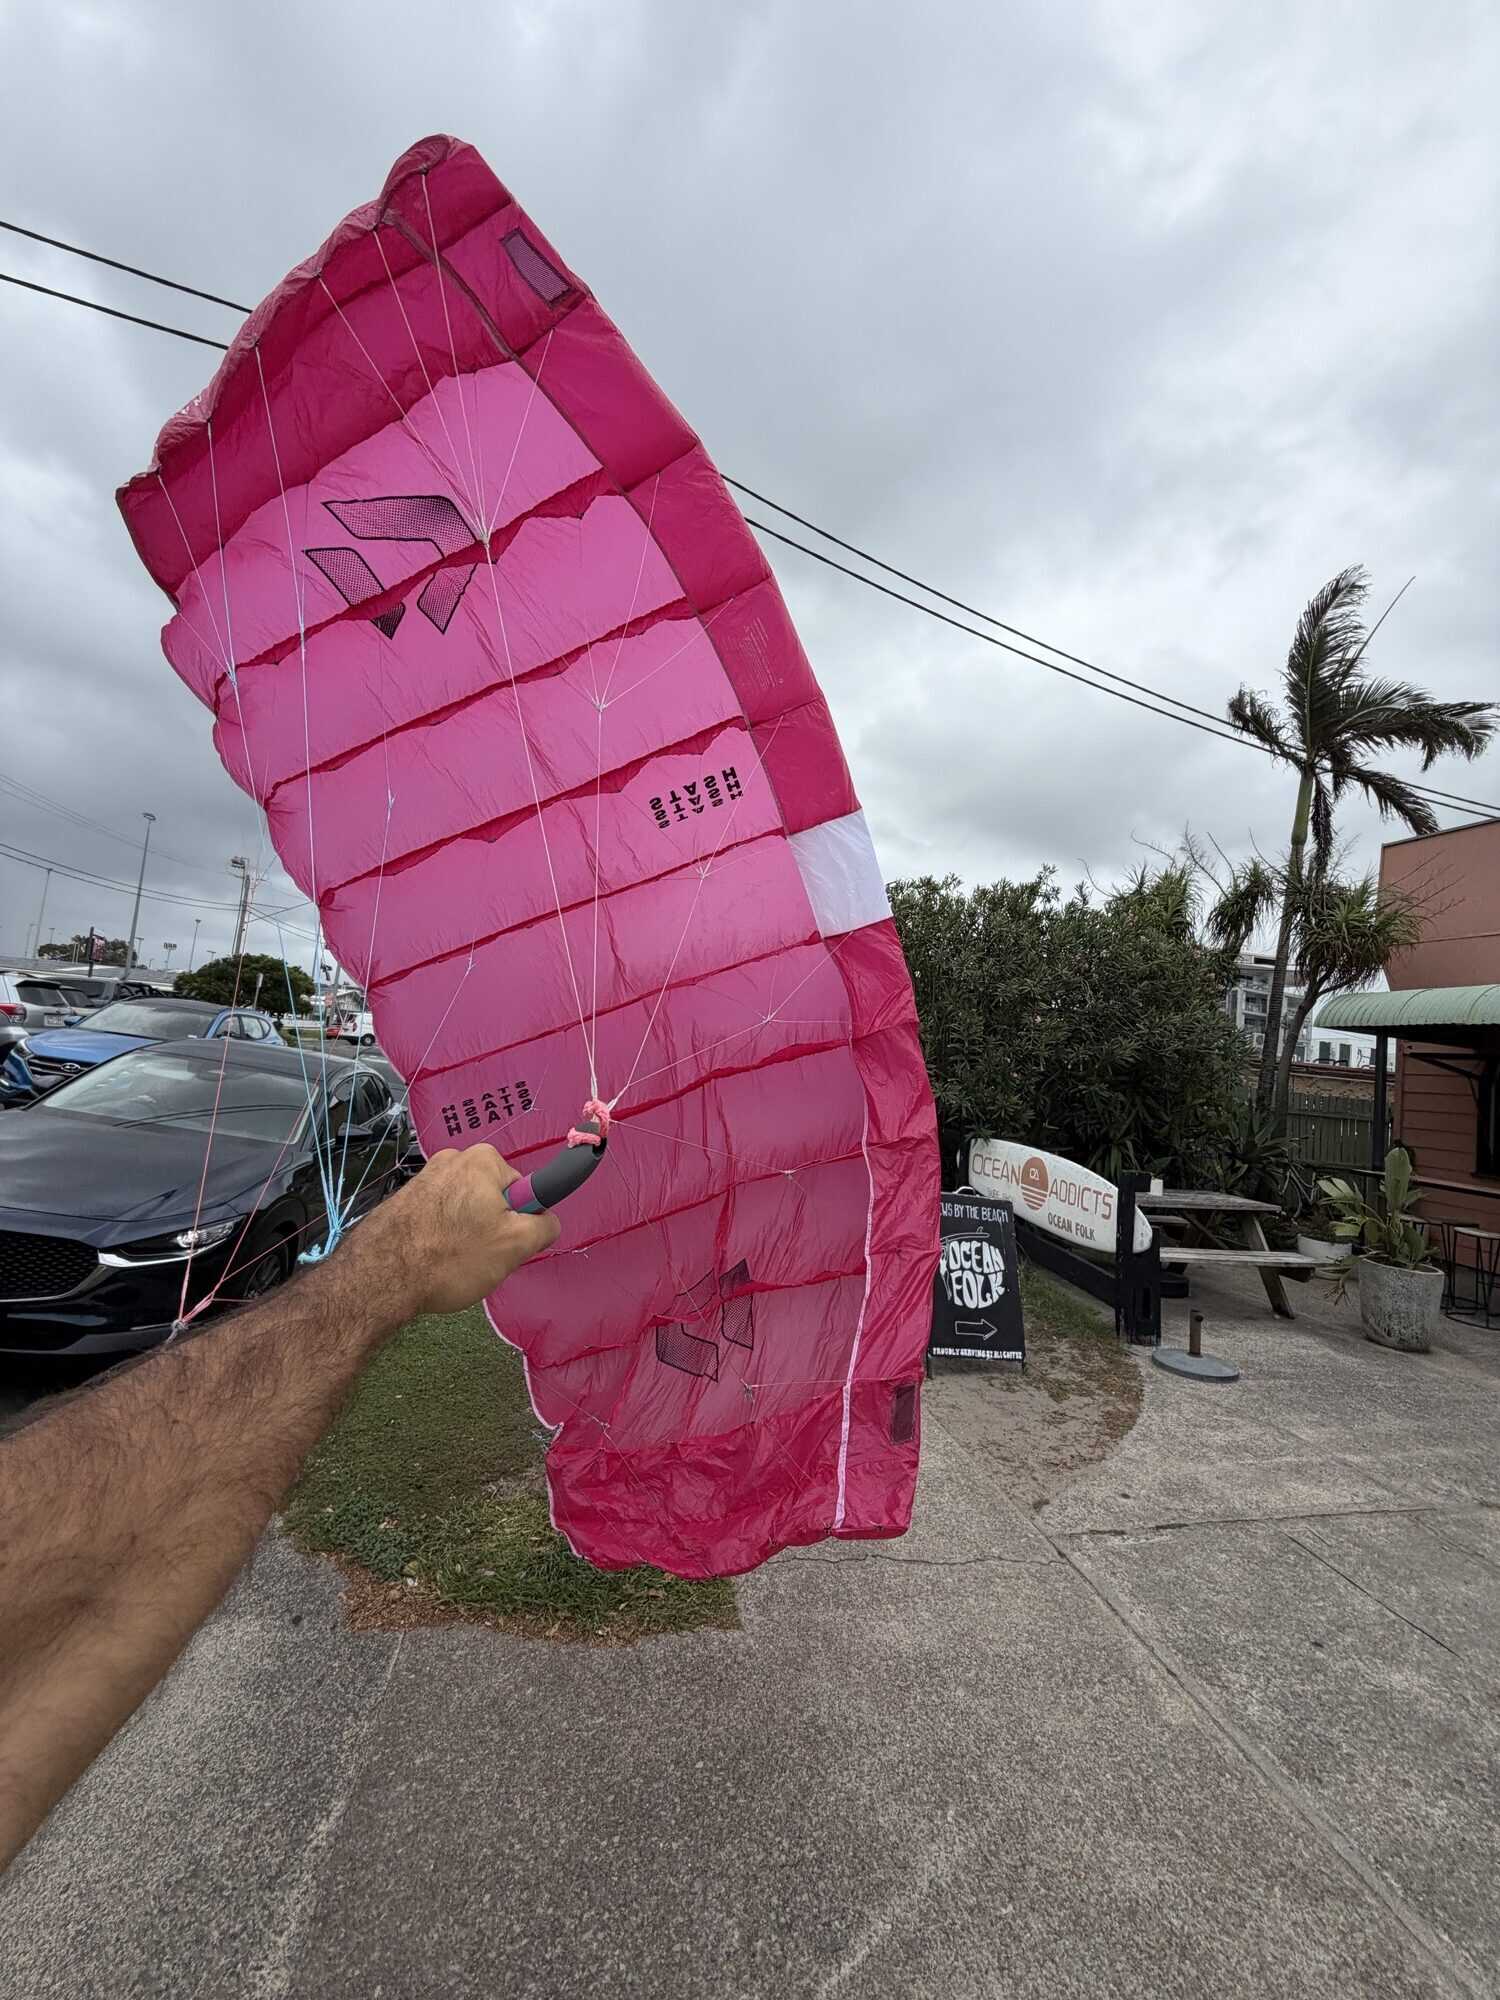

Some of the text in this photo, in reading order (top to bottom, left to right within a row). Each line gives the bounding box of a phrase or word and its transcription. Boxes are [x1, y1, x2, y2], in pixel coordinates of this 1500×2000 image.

[972, 1153, 1114, 1220] OCEAN ADDICTS
[954, 1204, 964, 1218] BY
[965, 1205, 980, 1220] THE
[981, 1207, 1008, 1223] BEACH
[1048, 1212, 1096, 1241] OCEAN FOLK
[949, 1240, 1005, 1274] OCEAN
[950, 1270, 1005, 1309] FOLK
